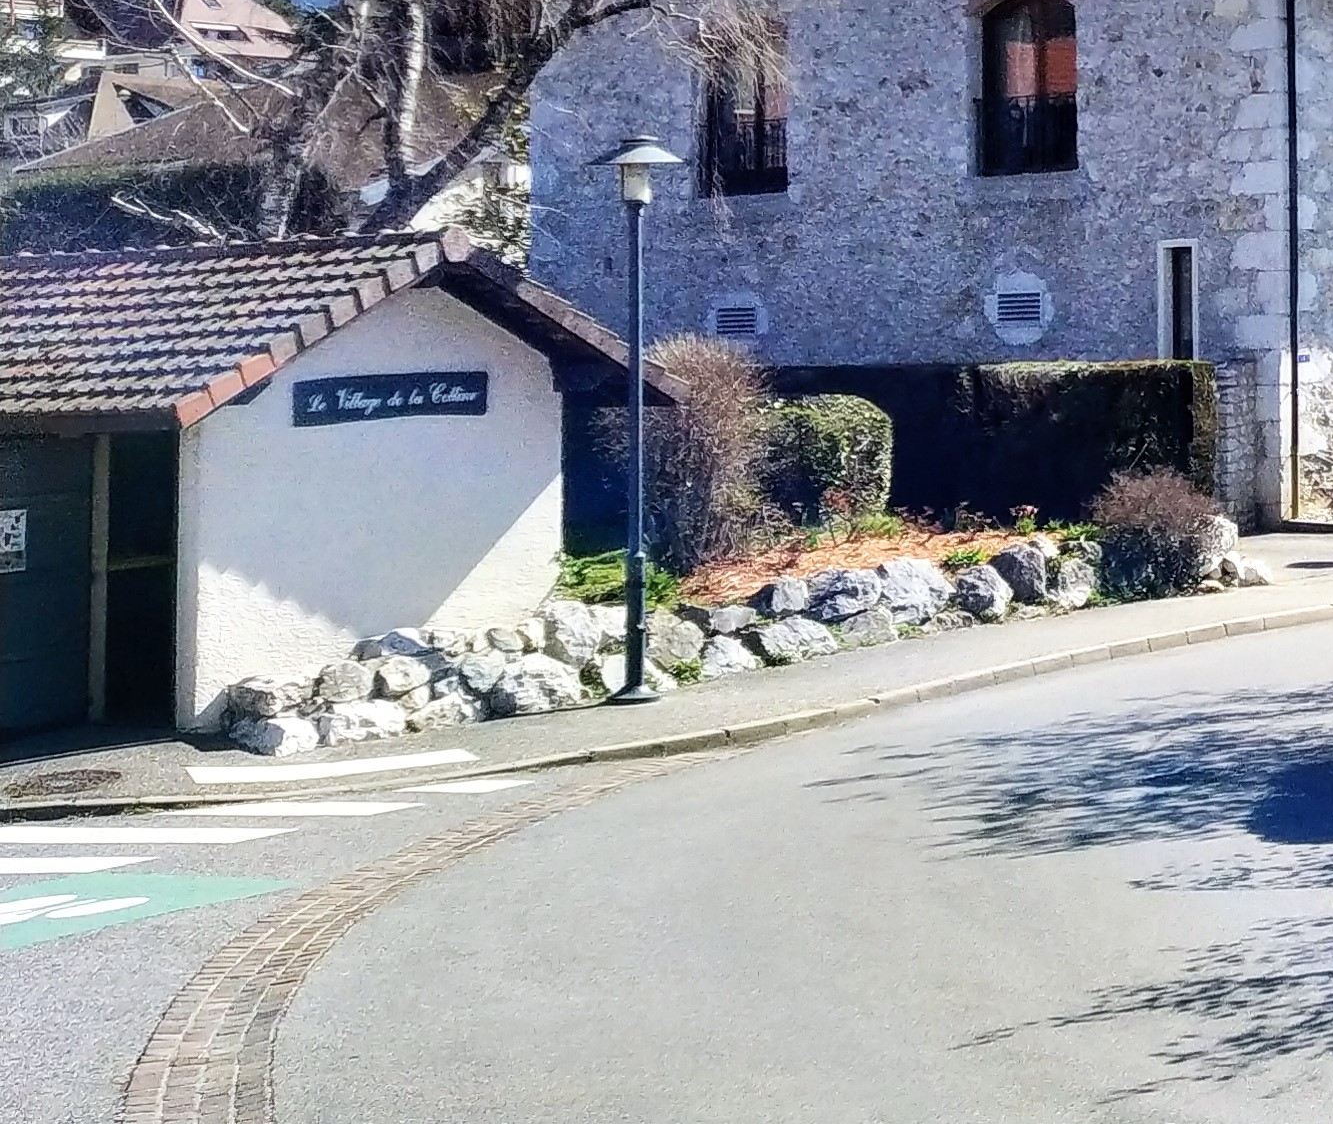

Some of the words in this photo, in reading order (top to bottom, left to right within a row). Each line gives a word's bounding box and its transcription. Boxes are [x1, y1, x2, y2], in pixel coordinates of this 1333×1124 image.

[306, 393, 327, 413] Le
[335, 387, 382, 416] Village
[386, 389, 404, 407] de
[407, 386, 424, 405] la
[429, 382, 479, 404] Colline
